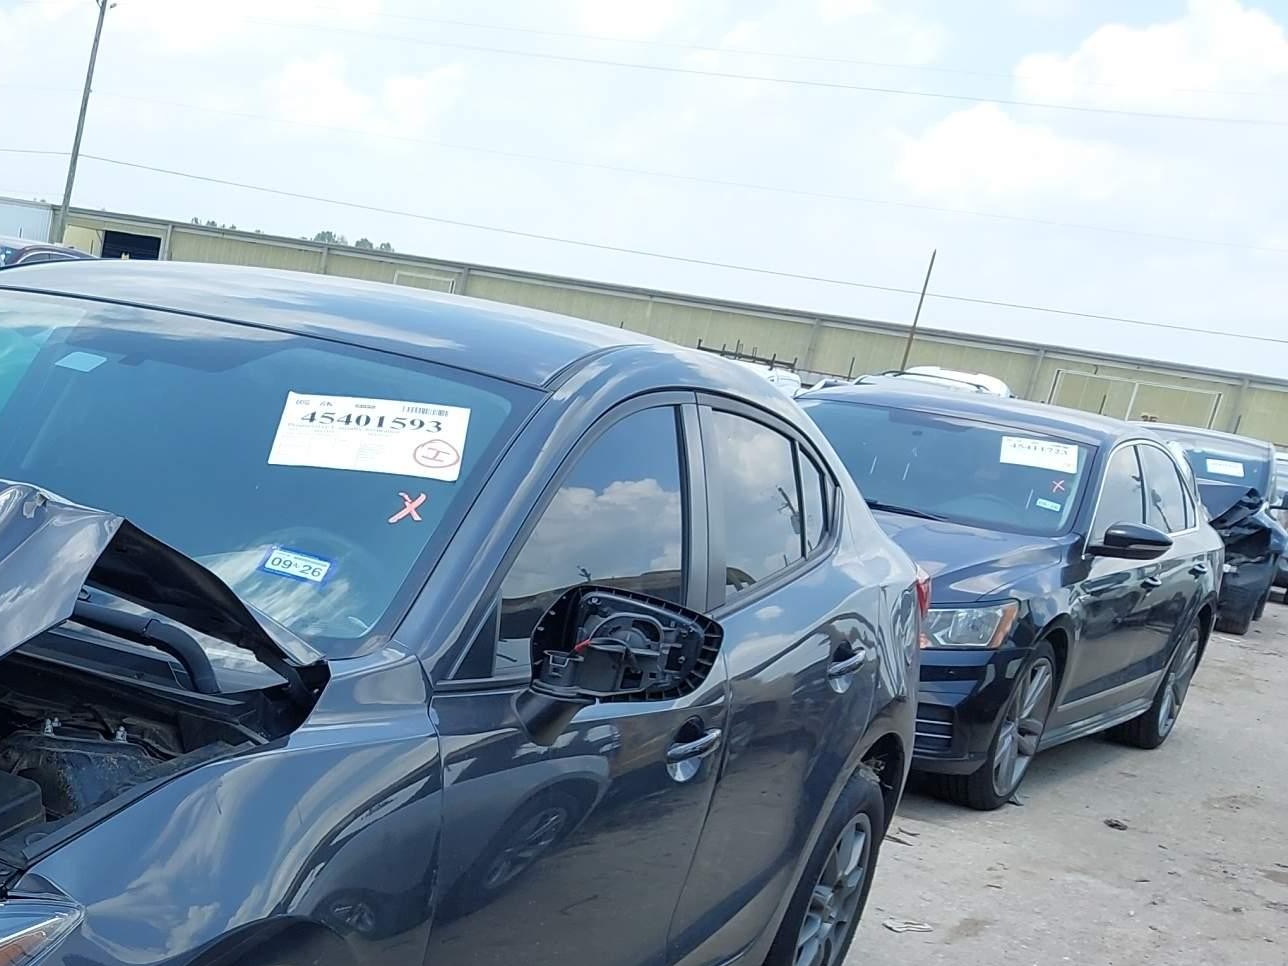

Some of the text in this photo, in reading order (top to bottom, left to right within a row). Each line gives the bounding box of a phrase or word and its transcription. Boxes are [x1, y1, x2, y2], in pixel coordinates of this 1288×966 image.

[300, 411, 443, 433] 45401593
[271, 556, 293, 569] 09
[298, 564, 323, 577] 26
